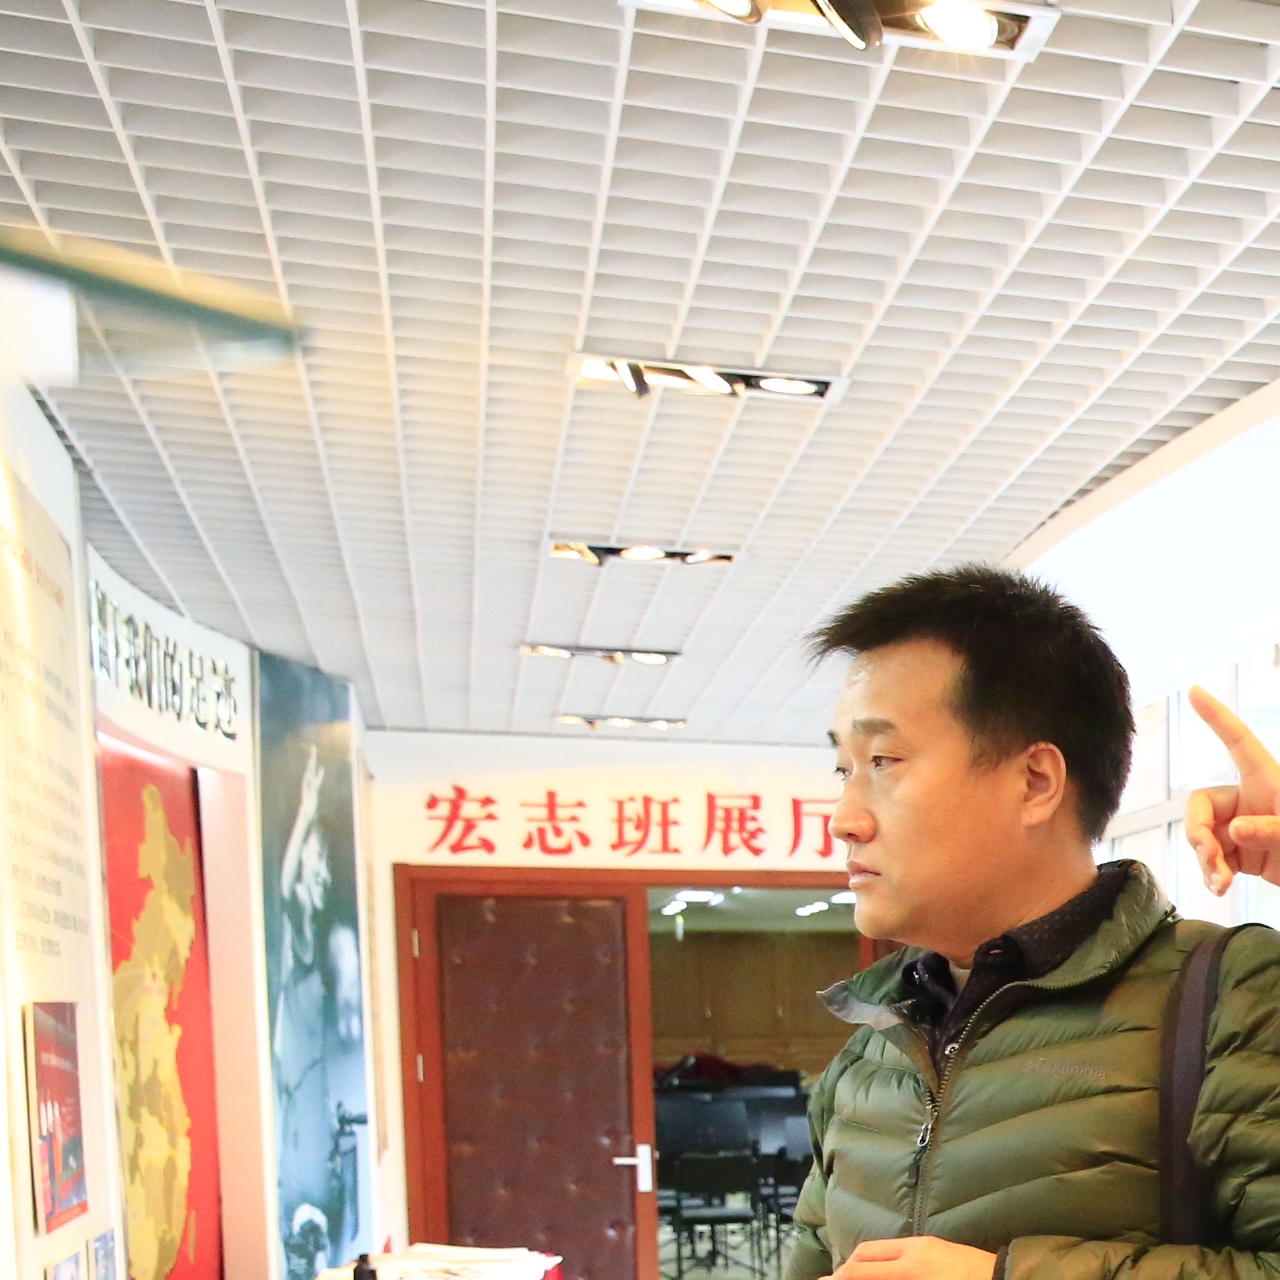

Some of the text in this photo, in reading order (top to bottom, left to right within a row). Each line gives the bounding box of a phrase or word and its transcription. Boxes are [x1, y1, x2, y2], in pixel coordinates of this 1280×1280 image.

[425, 785, 839, 859] 宏志班展厅
